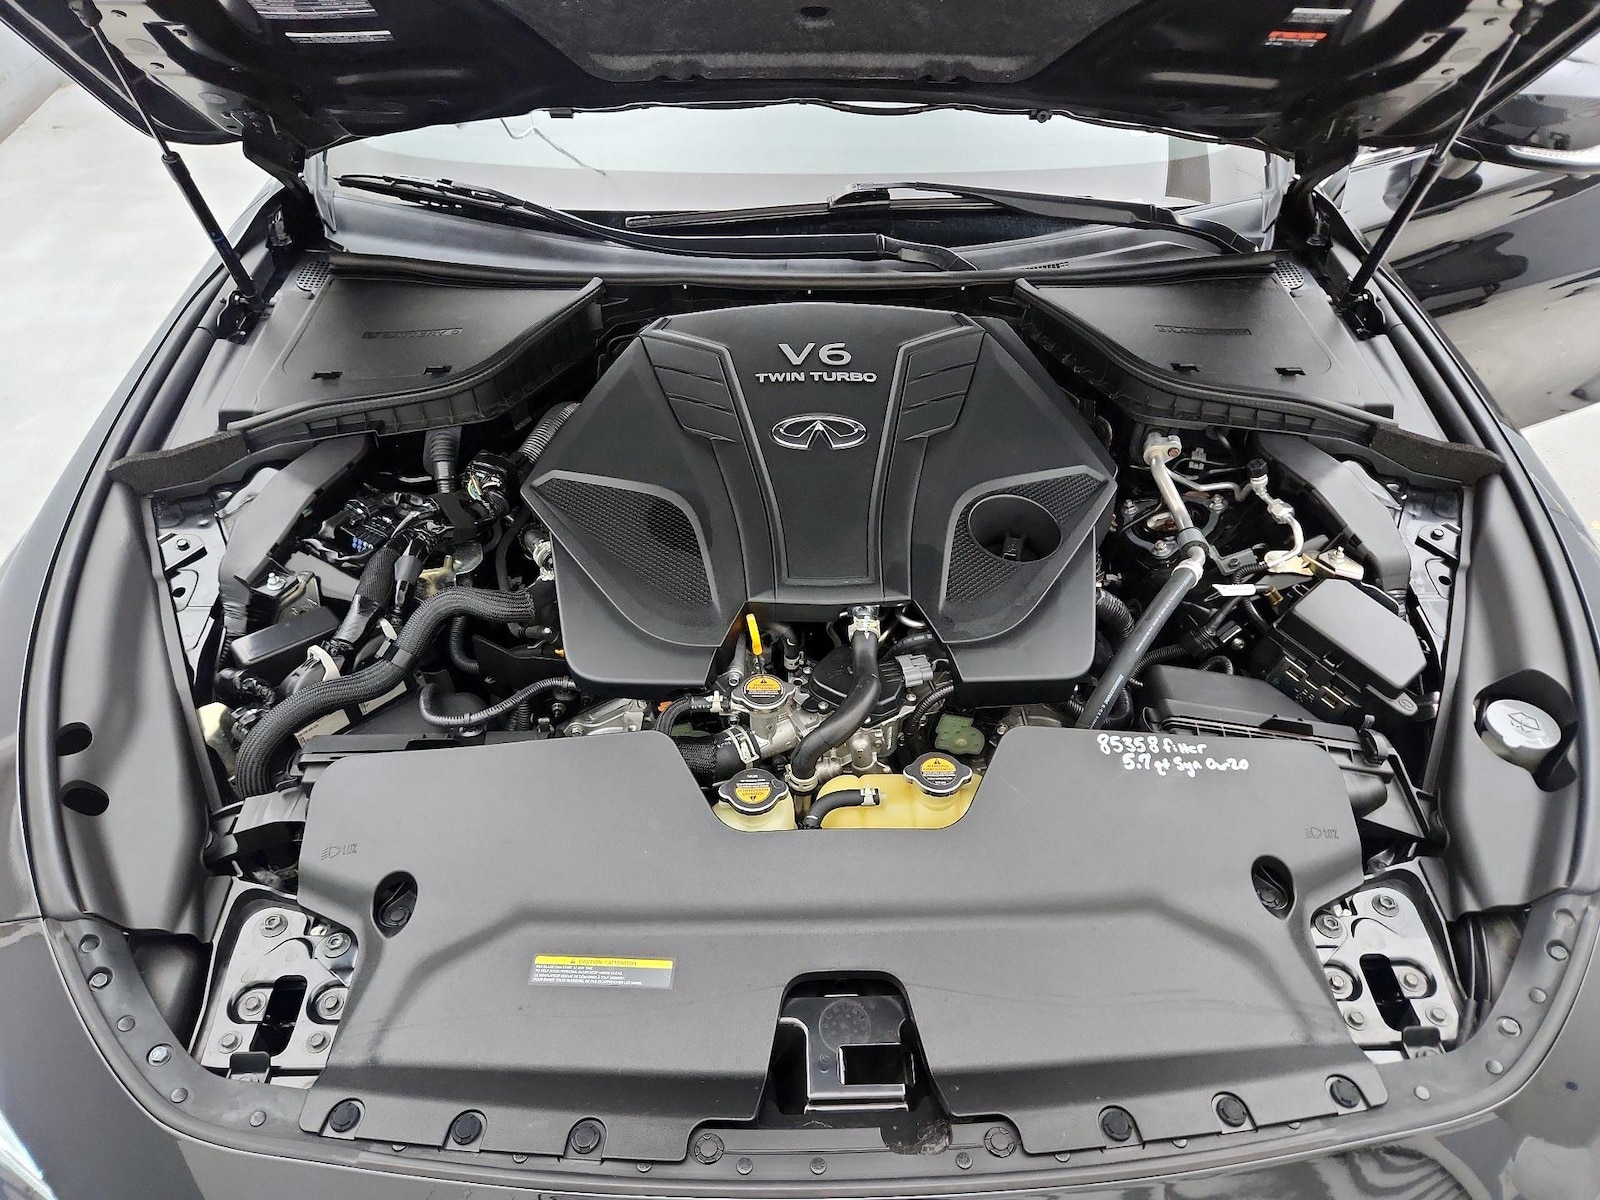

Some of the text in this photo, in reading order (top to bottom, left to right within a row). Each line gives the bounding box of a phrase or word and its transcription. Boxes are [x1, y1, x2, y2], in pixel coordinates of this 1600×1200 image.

[778, 342, 852, 366] V6
[755, 371, 878, 383] TWIN TURBO
[1097, 733, 1207, 755] 85358 filter
[1122, 752, 1151, 770] 5.7
[1173, 756, 1203, 778] Syn
[578, 958, 603, 966] CAUTION
